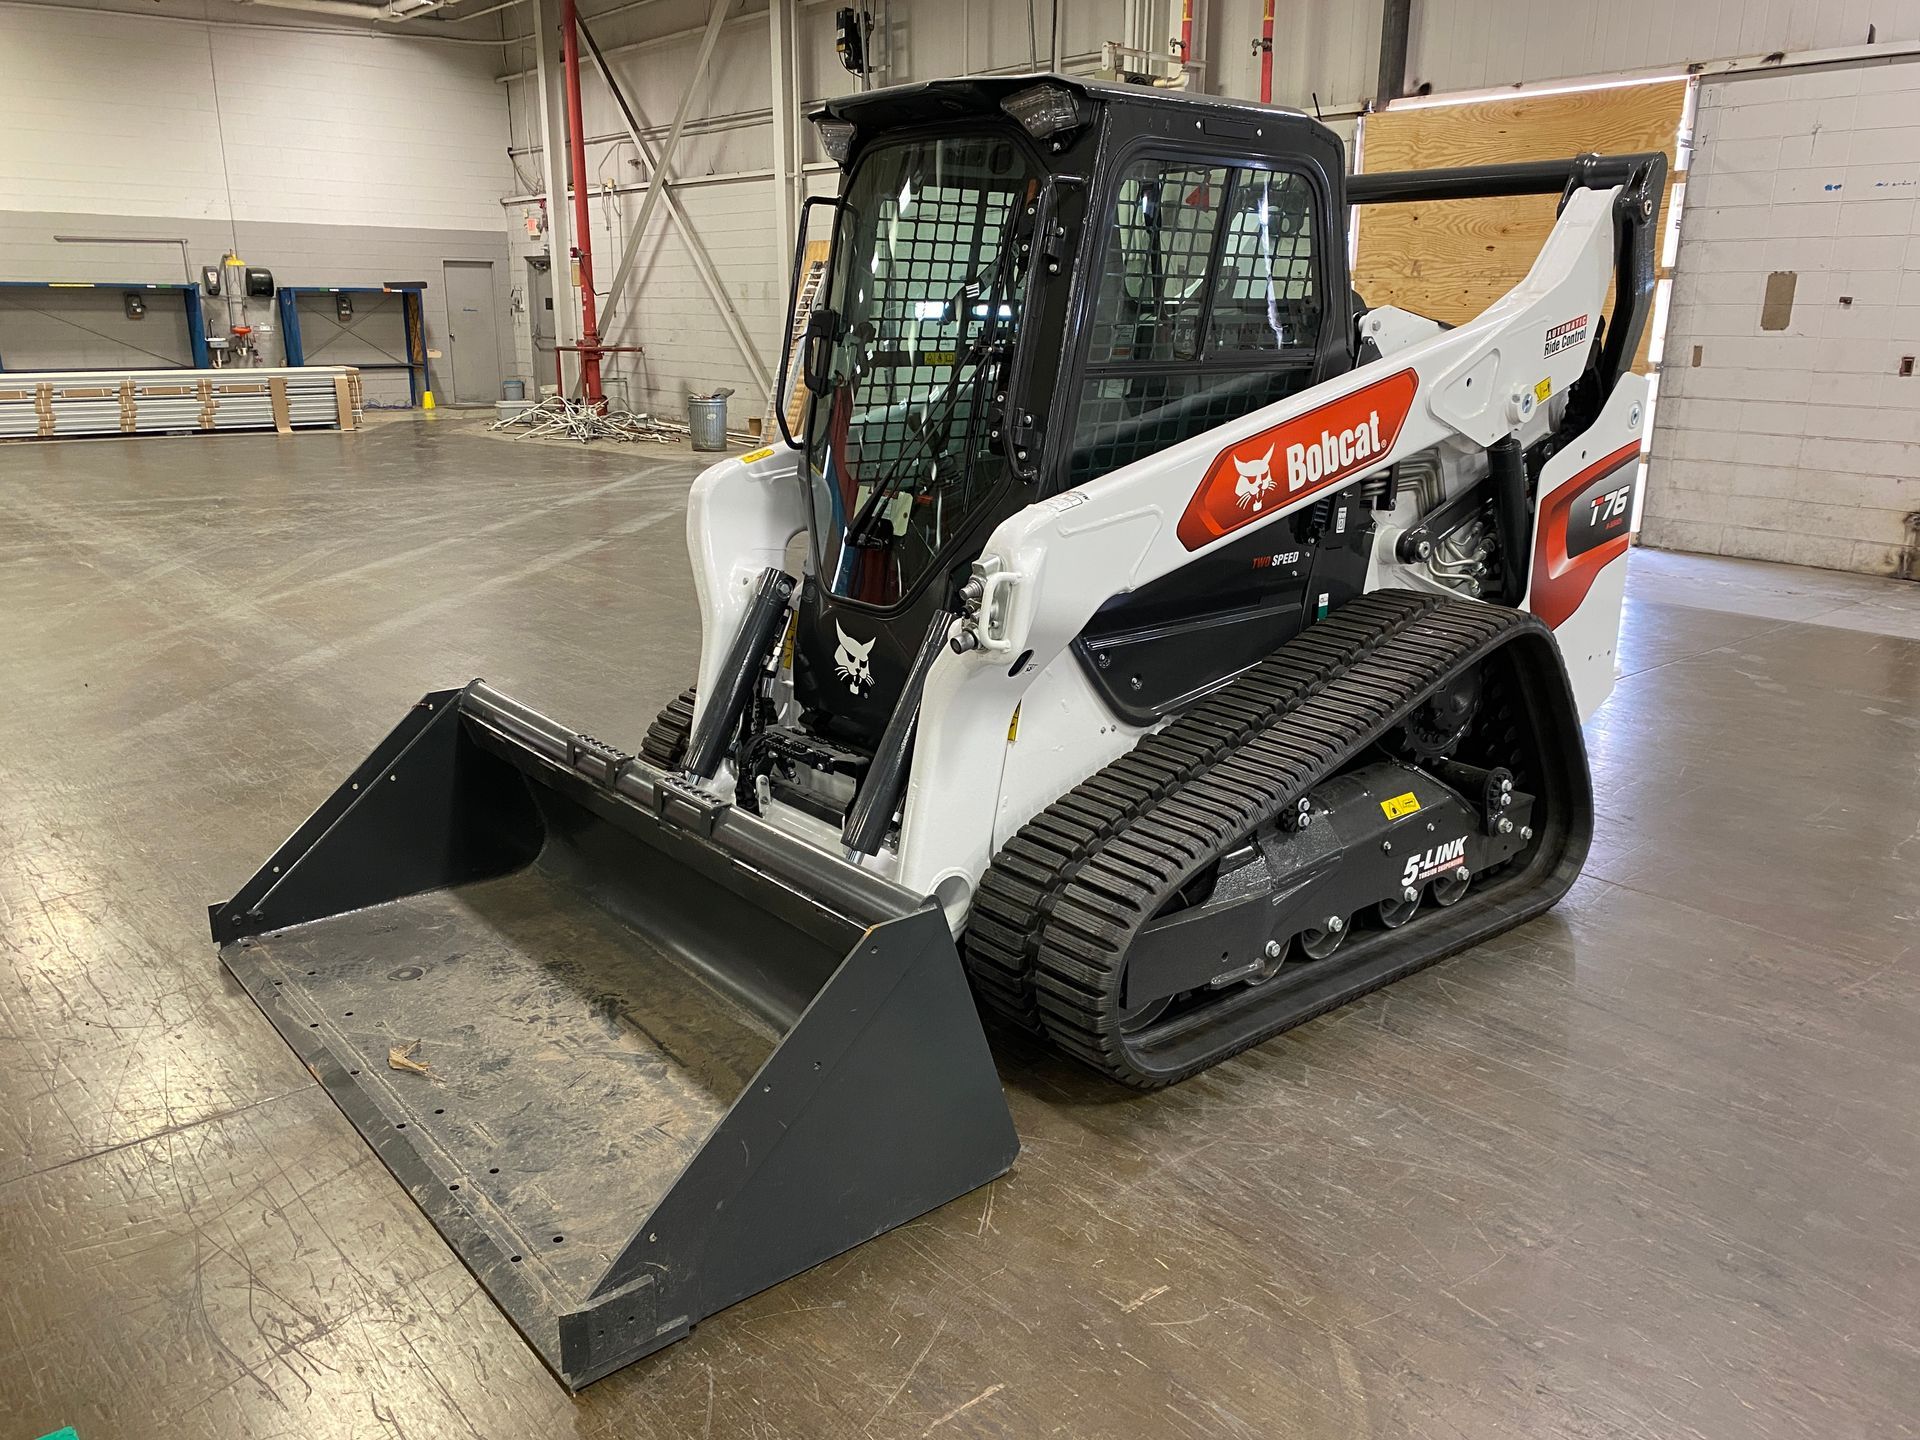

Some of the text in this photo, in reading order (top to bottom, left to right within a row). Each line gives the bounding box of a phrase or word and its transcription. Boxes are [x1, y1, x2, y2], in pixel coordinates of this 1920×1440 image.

[1544, 326, 1587, 356] Ride Control
[1546, 316, 1587, 340] AUTOMATIC
[1286, 410, 1381, 493] Bobcat
[1590, 484, 1630, 527] T76
[1252, 551, 1300, 569] TWO SPEED
[1401, 835, 1469, 887] 5-LINK
